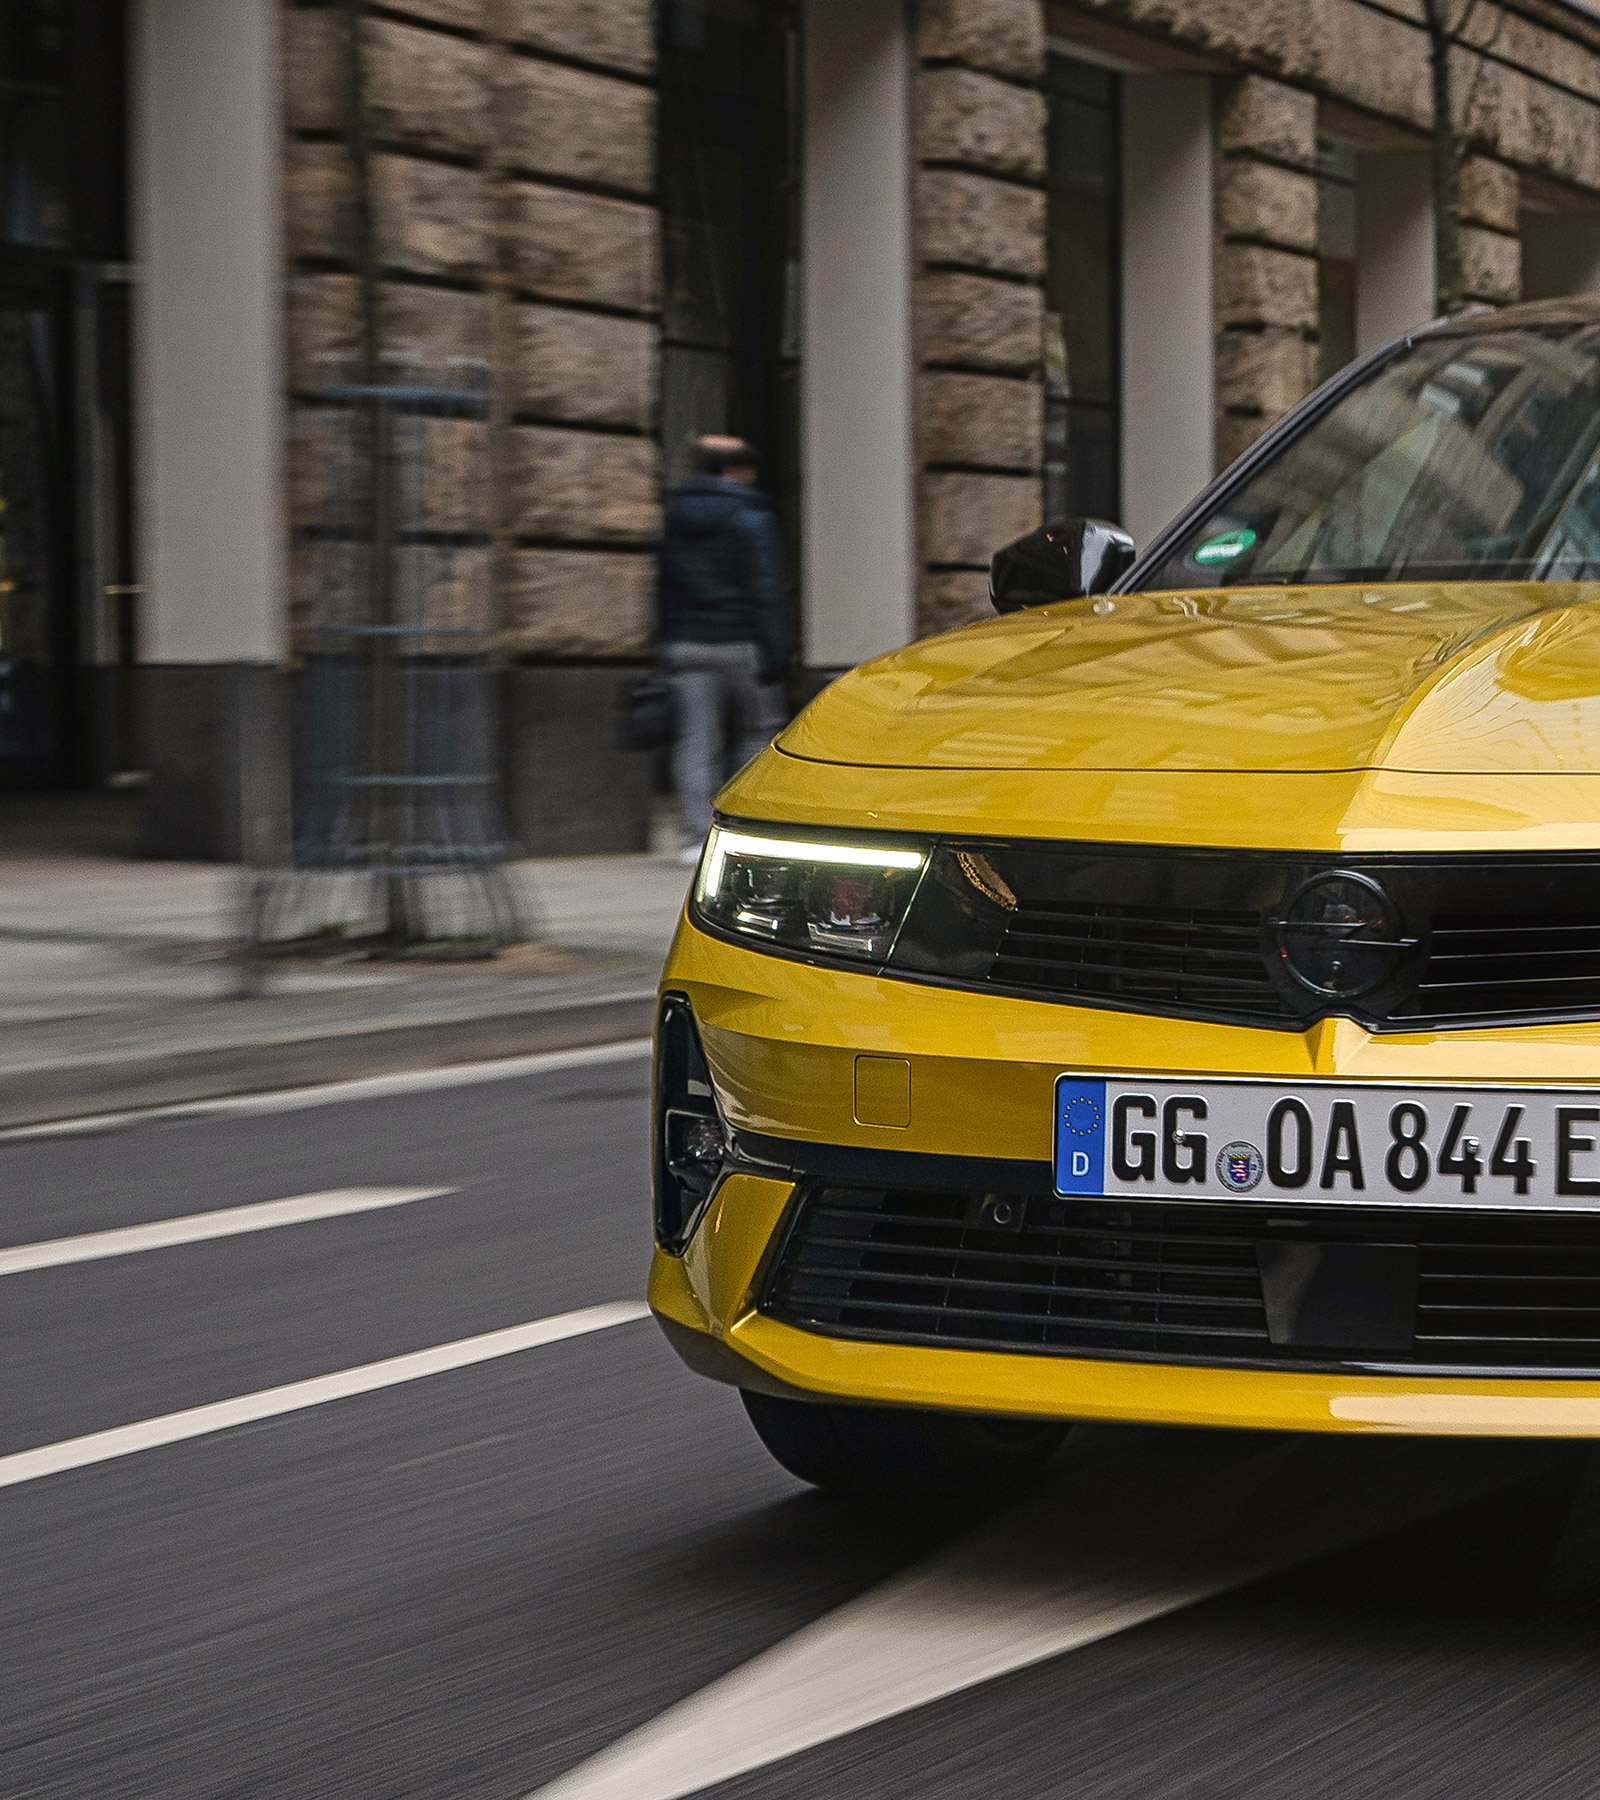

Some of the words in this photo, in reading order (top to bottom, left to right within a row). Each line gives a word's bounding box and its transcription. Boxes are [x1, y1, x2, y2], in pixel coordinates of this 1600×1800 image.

[1072, 1152, 1089, 1176] D
[1111, 1094, 1208, 1184] GG
[1266, 1097, 1366, 1190] OA
